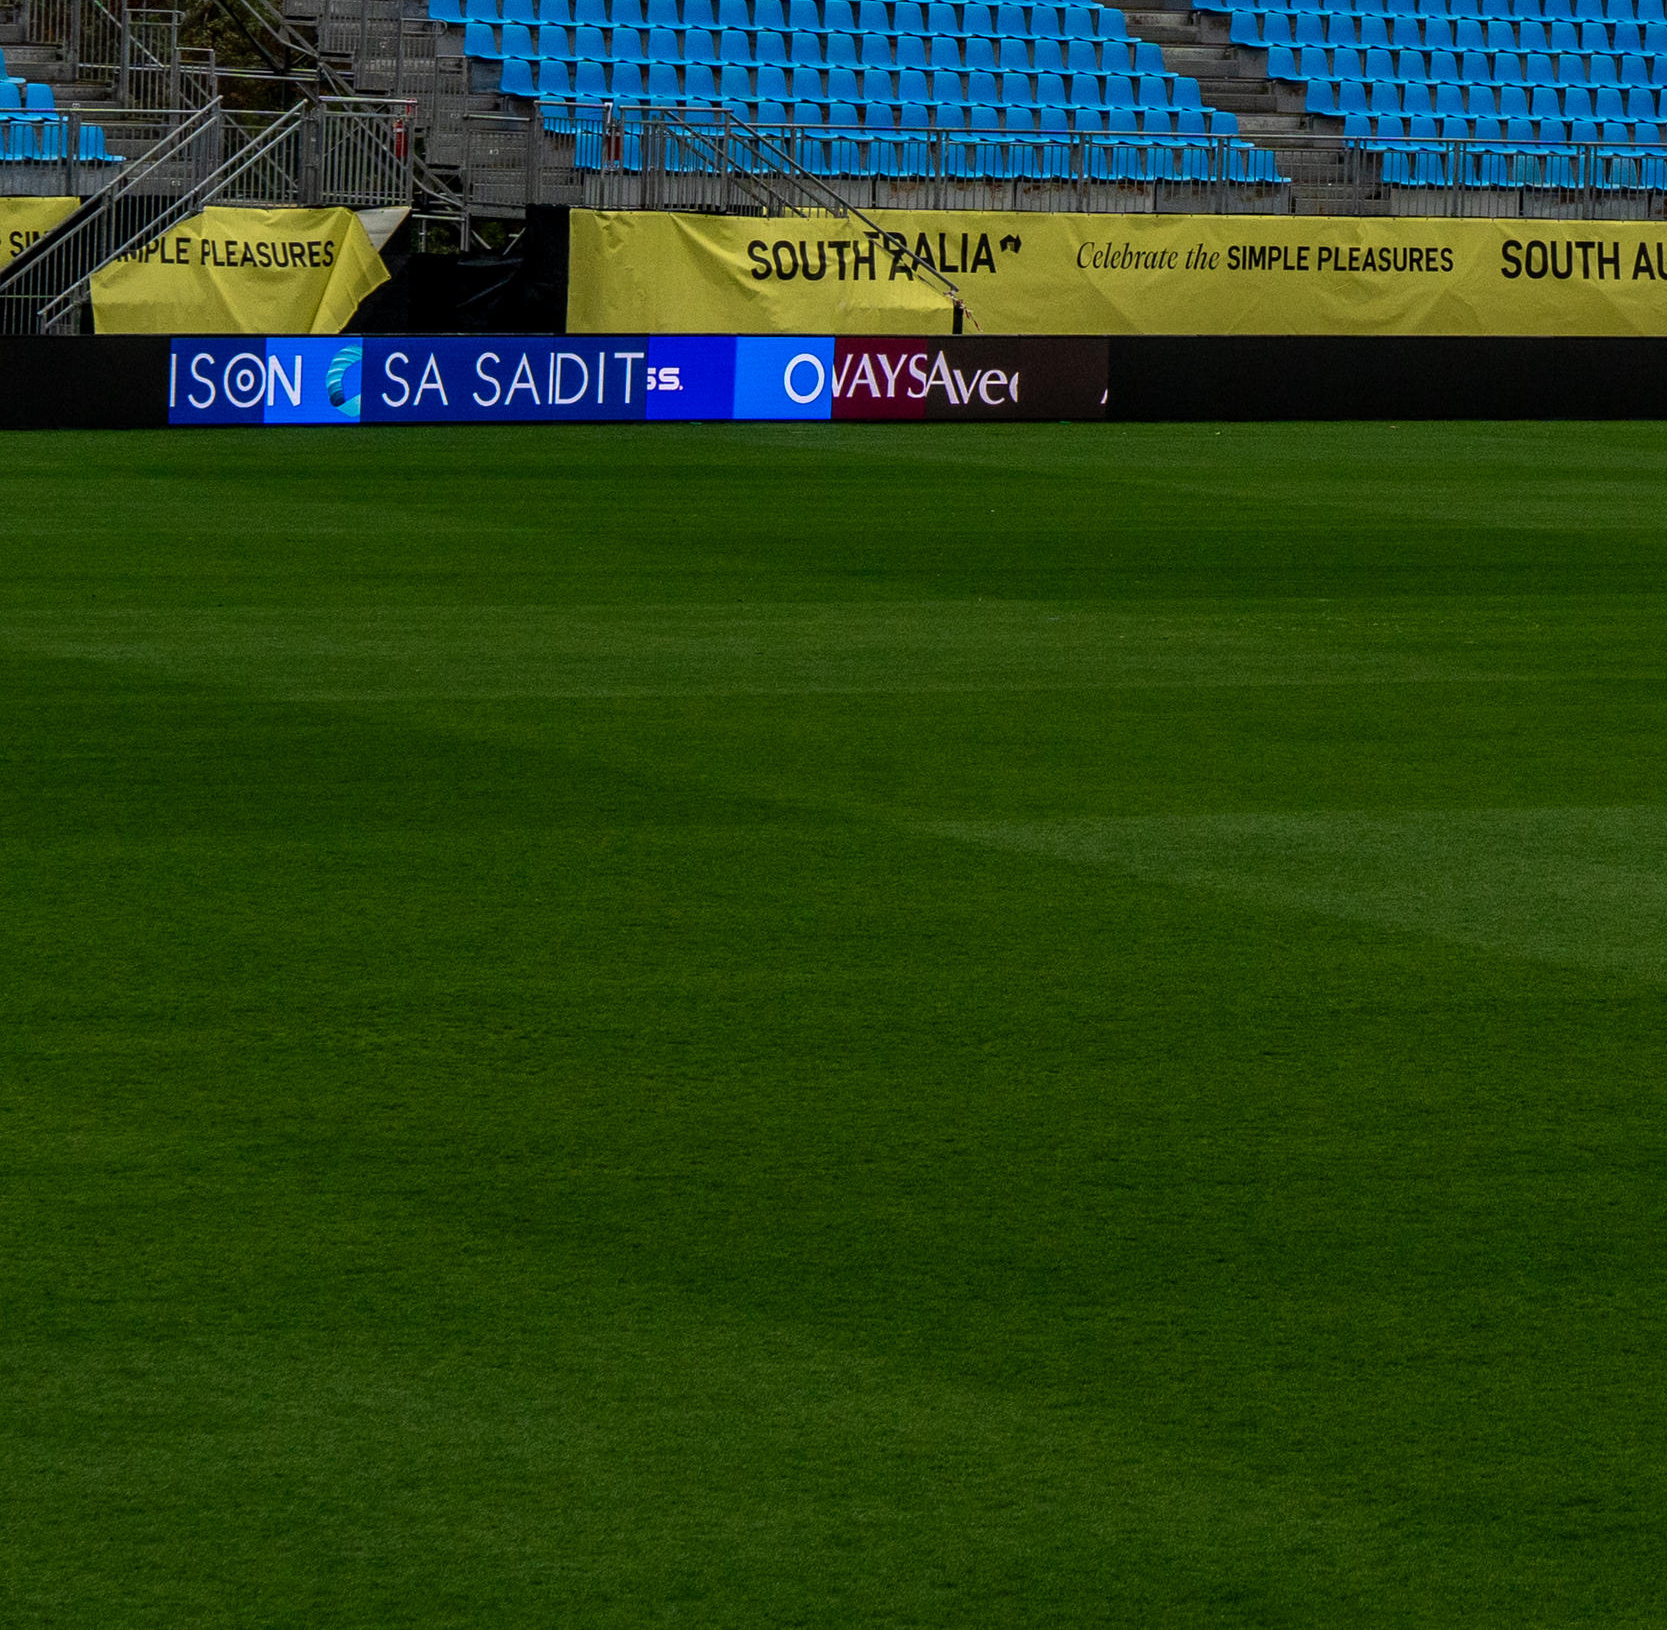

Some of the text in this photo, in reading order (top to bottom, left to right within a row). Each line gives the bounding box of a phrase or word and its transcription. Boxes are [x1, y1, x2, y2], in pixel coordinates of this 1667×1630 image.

[200, 238, 334, 268] PLEASURES
[747, 240, 876, 281] SOUTH
[1076, 241, 1454, 272] Celebrate the SIMPLE PLEASURES
[1501, 240, 1620, 280] SOUTH
